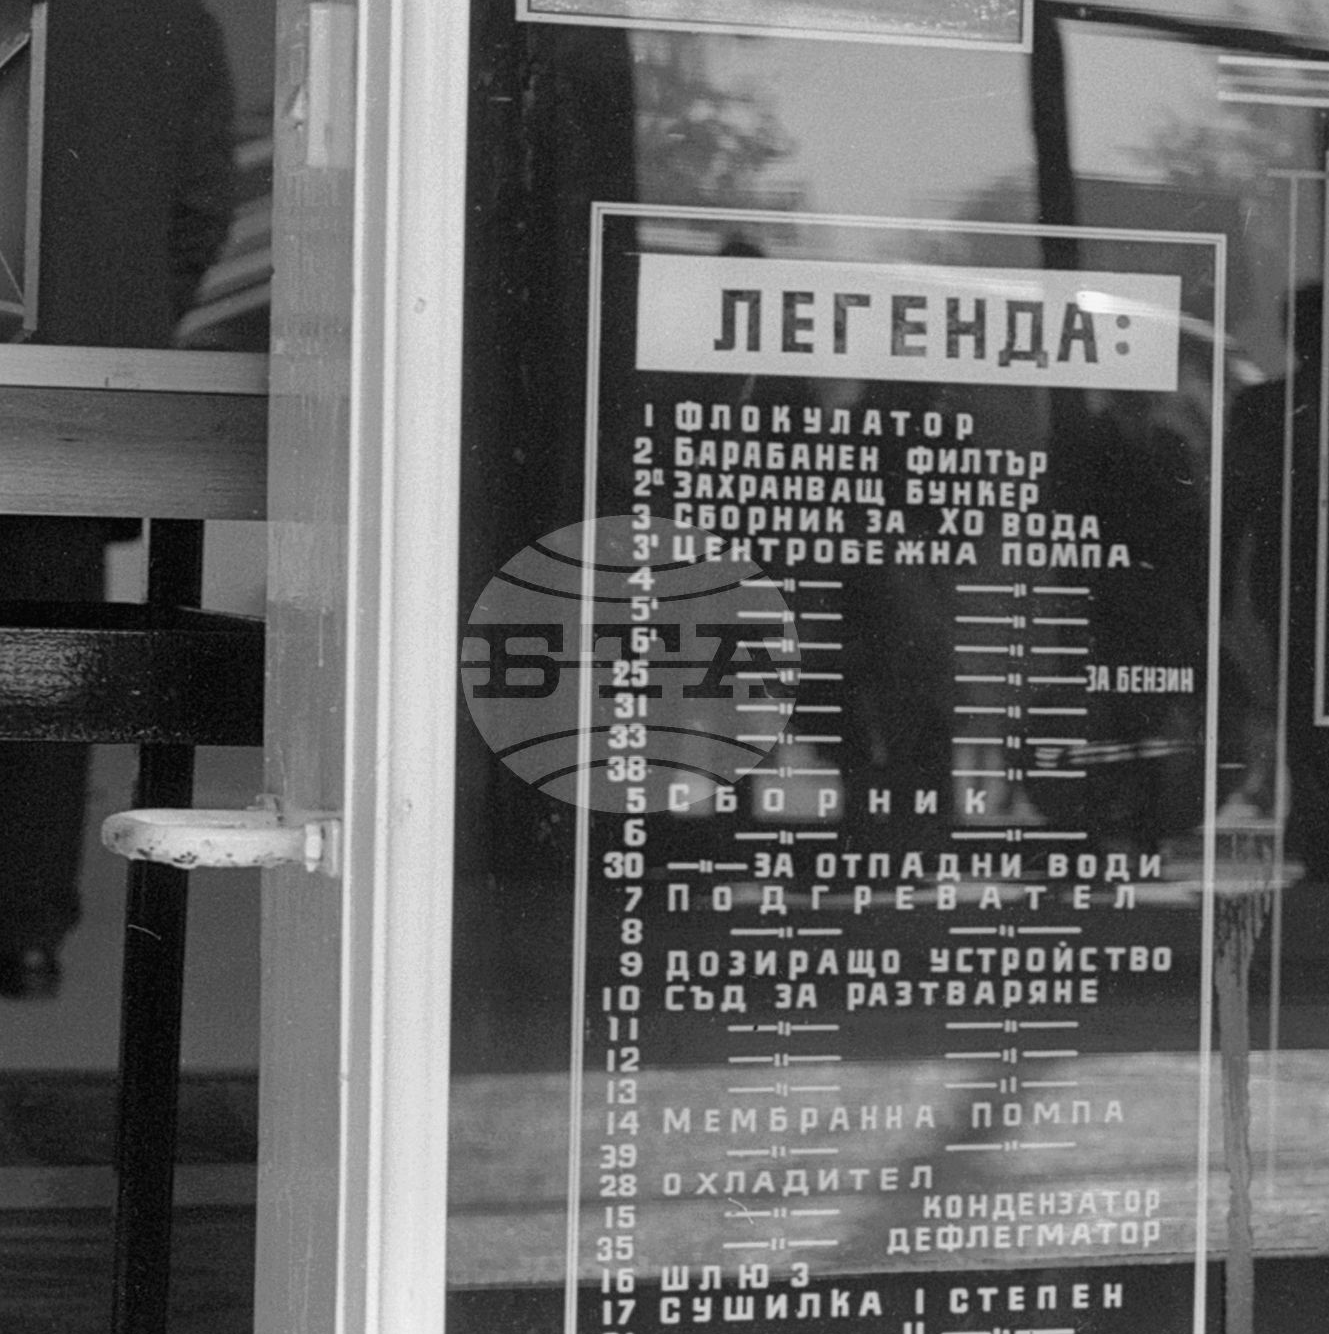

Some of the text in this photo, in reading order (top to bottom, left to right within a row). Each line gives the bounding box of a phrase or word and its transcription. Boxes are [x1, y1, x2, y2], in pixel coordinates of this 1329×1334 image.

[645, 403, 972, 439] 1 ФЛОКУЛАТОР
[634, 437, 1046, 474] 2 БАРАБАНЕН ФИЛТЪР
[674, 471, 1037, 508] ЗАХРАНВАЩ БУНКЕР
[633, 503, 1099, 541] 3 СБОРНИК ЗА ХО ВОДА
[674, 536, 1130, 567] ЦЕНТРОБЕЖНА ПОМПА
[612, 659, 1193, 692] 25 ЗА БЕНЗИН
[627, 786, 984, 815] 5 СБОРНИК
[604, 852, 1160, 881] 30 ЗА ОТПАДНИ ВОДИ
[626, 884, 1135, 915] 7 ПОДГРЕВАТЕЛ
[621, 942, 1171, 981] 9 ДОЗИРАЩО УСТРОЙСТВО
[603, 979, 1097, 1012] 10 СЪД ЗА РАЗТВАРЯНЕ
[608, 1101, 1121, 1135] 14 МЕМБРАННА ПОМПА
[600, 1165, 932, 1196] 28 ОХЛАДИТЕЛ
[606, 1190, 1159, 1228] 15 КОНДЕНЗАТОР
[597, 1221, 1159, 1261] 35 ДЕФЛЕГМАТОР
[602, 1263, 808, 1293] 16 ШЛЮЗ
[603, 1300, 635, 1325] 17
[661, 1289, 881, 1323] СУШИЛКА
[950, 1284, 1122, 1313] СТЕПЕН
